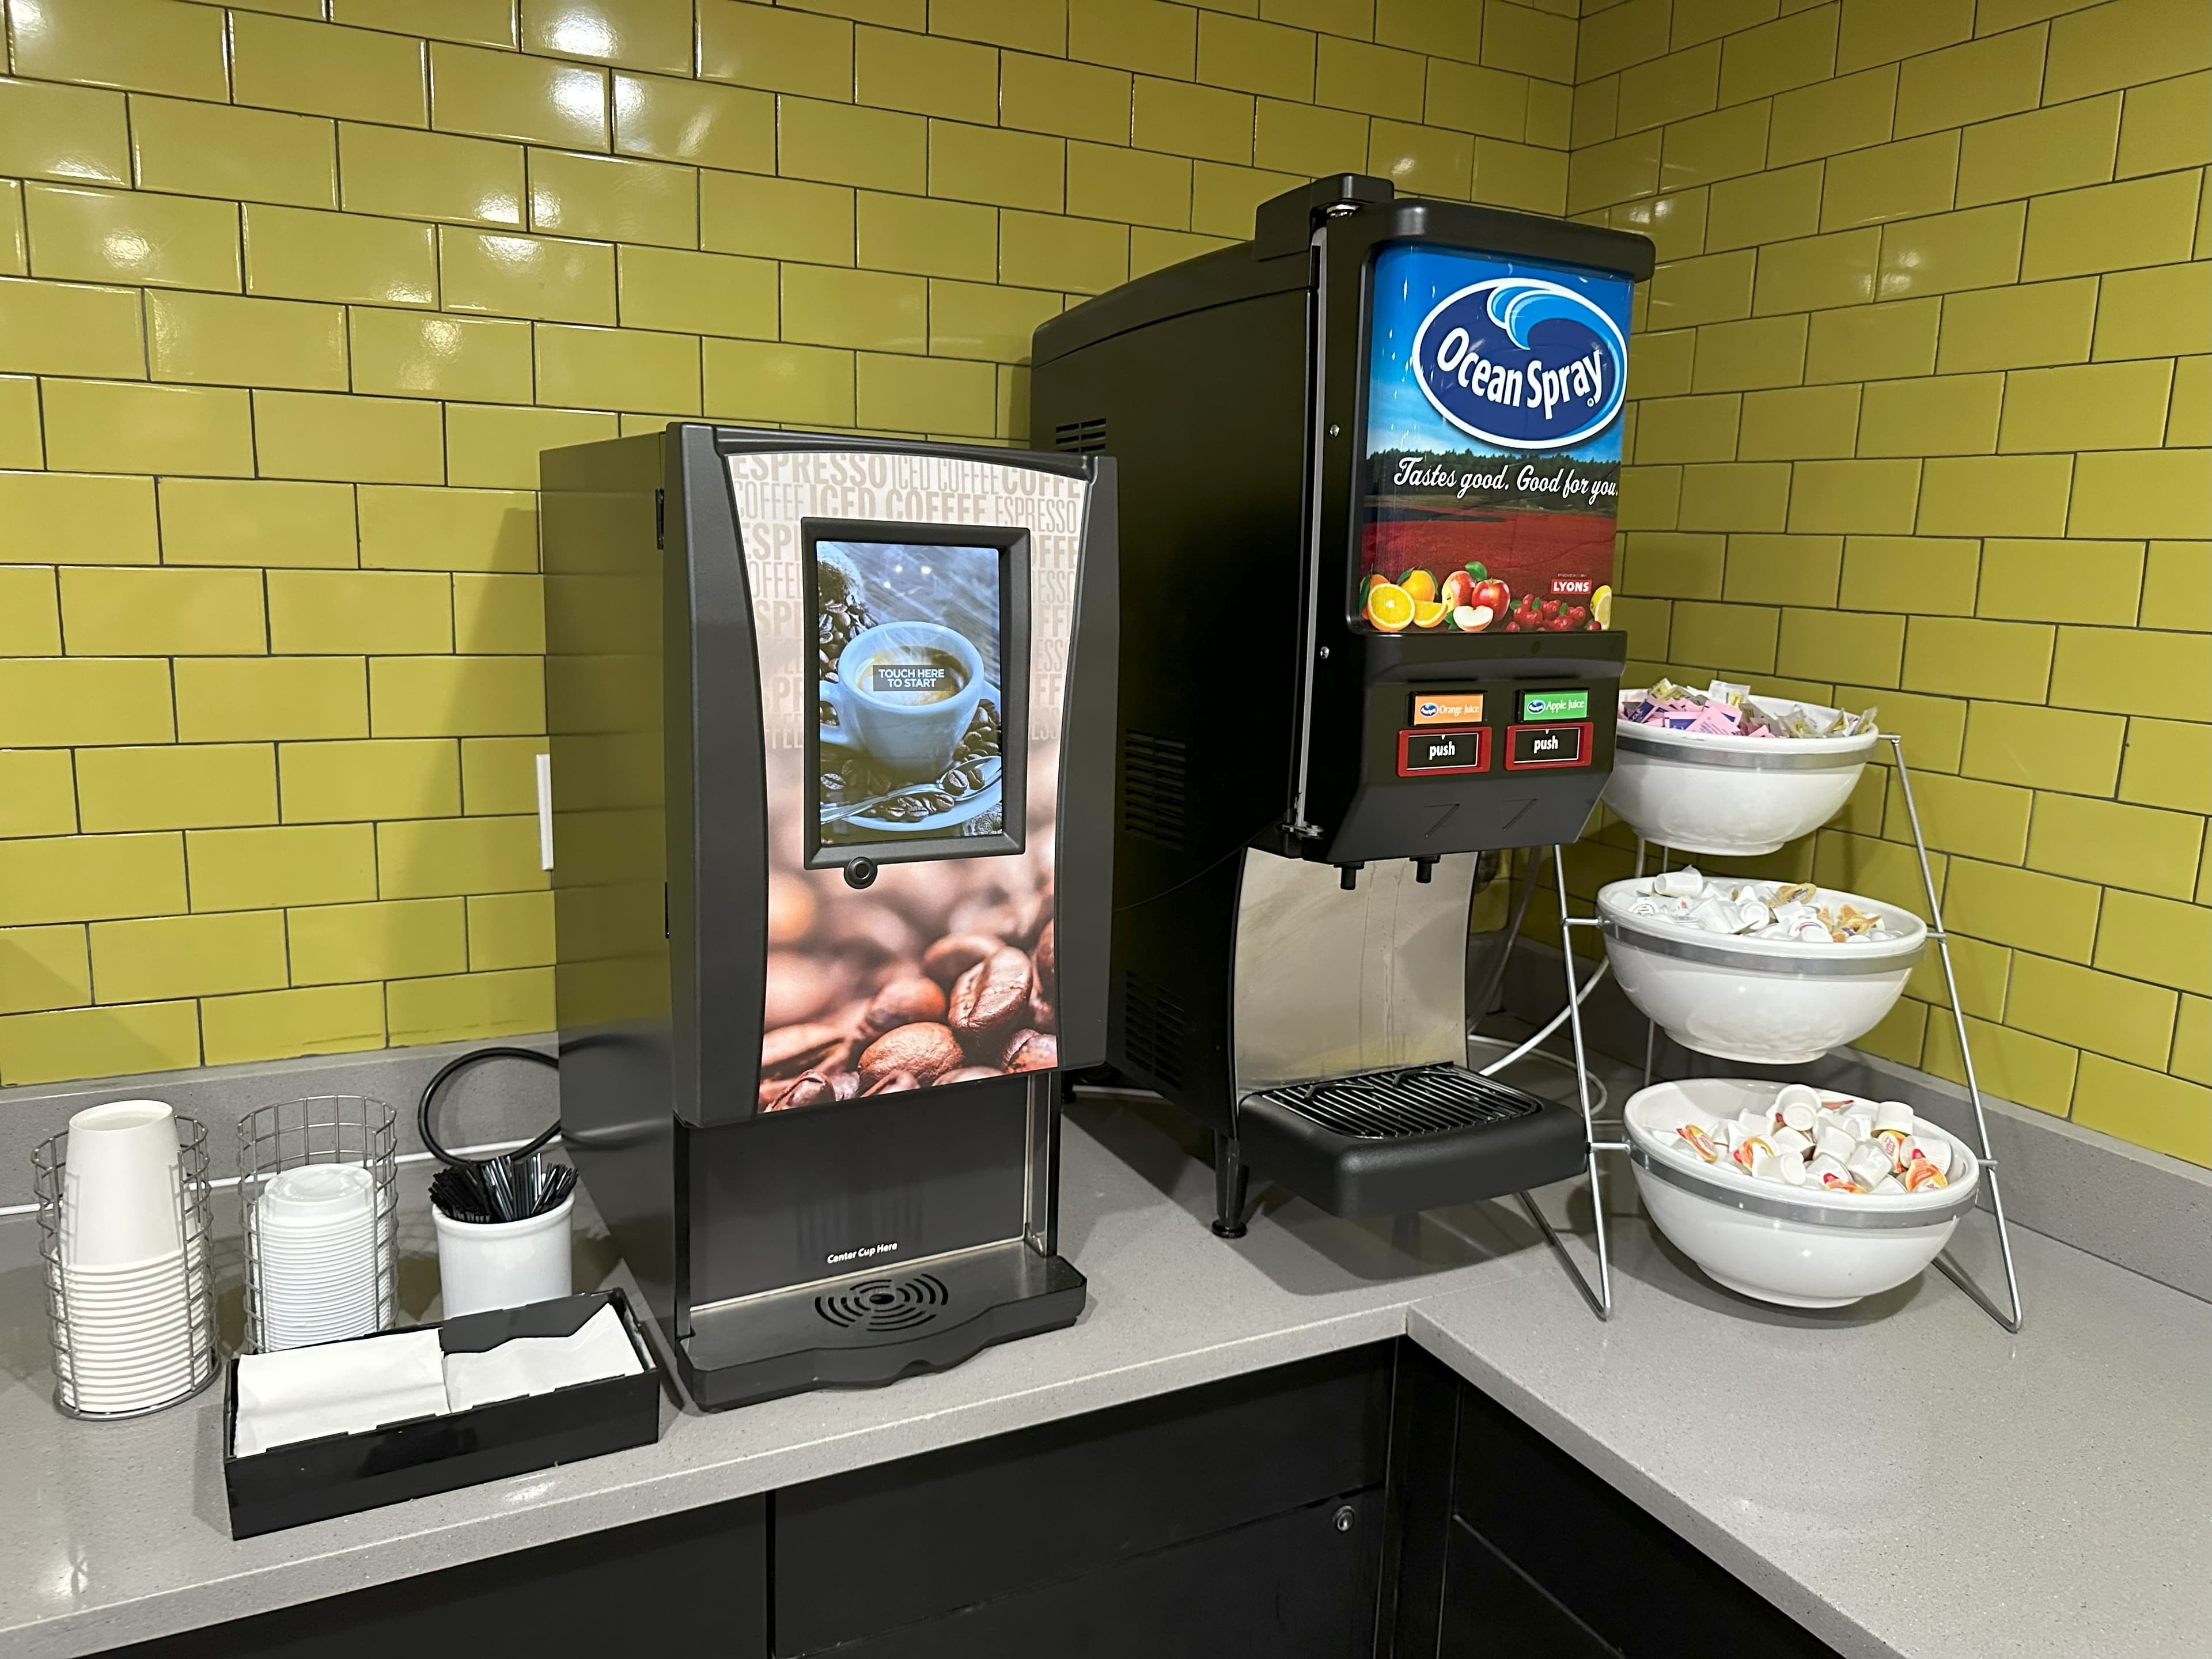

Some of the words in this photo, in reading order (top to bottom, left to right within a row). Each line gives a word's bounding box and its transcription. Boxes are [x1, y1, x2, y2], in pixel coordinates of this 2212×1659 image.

[1437, 327, 1523, 408] Ocean
[1527, 349, 1603, 420] Spray
[732, 454, 887, 488] ESPRESSO
[892, 455, 930, 491] ICED
[937, 459, 999, 495] COFFEE
[1393, 457, 1457, 488] Tastes
[1456, 464, 1509, 499] good.
[1516, 464, 1562, 491] Good
[1562, 468, 1589, 499] for
[1588, 480, 1619, 506] you.
[995, 495, 1077, 534] ESPRESSO
[1554, 581, 1590, 592] LYONS
[878, 669, 915, 679] TOUCH
[918, 669, 945, 678] HERE
[887, 679, 903, 687] TO
[904, 679, 937, 687] START
[1439, 704, 1463, 718] Orange
[1464, 704, 1480, 715] Juice
[1546, 699, 1567, 714] Apple
[1568, 699, 1585, 711] Juice
[1429, 741, 1456, 760] push
[1533, 735, 1559, 754] push
[827, 1251, 857, 1264] Center
[857, 1248, 876, 1257] Cup
[877, 1243, 897, 1253] Here
